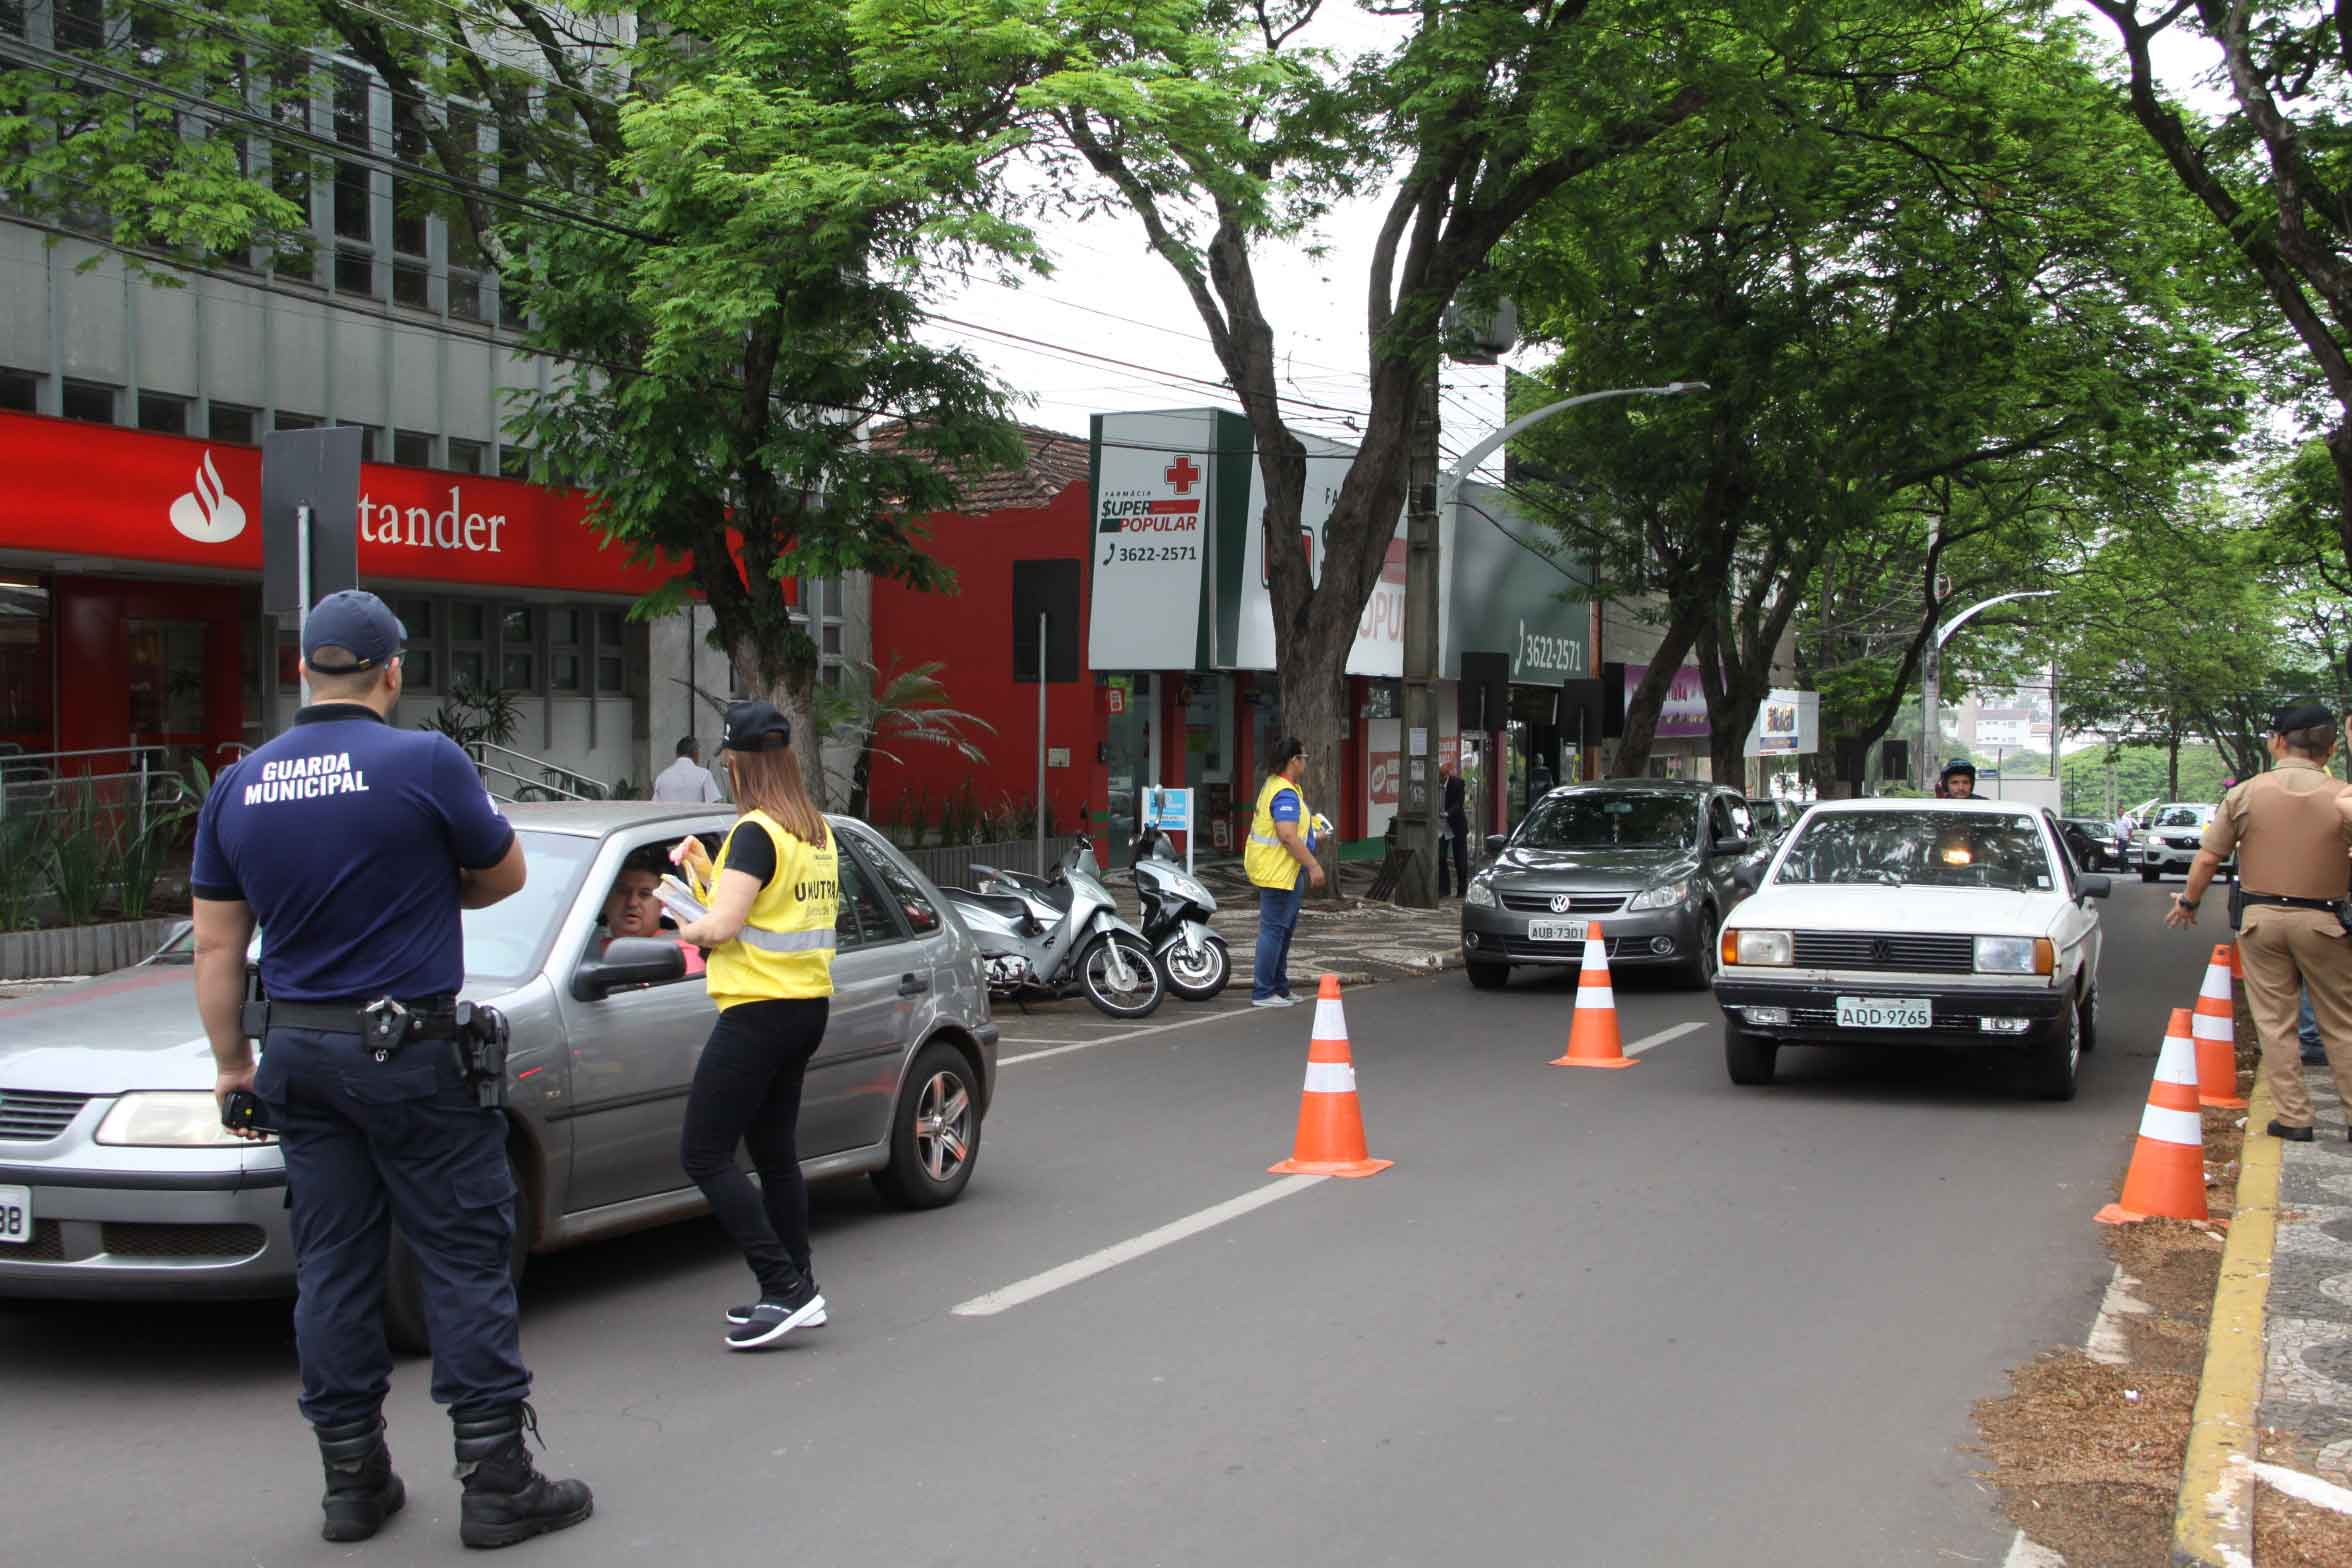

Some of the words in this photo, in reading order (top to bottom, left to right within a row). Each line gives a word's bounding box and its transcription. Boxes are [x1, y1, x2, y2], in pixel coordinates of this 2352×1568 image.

[358, 485, 506, 553] tander
[1120, 516, 1197, 533] POPULAR
[1119, 545, 1197, 562] 3622-2571
[1360, 591, 1406, 641] OPU
[1526, 634, 1582, 672] 3622-2571
[262, 752, 351, 782] GUARDA
[244, 770, 370, 806] MUNICIPAL
